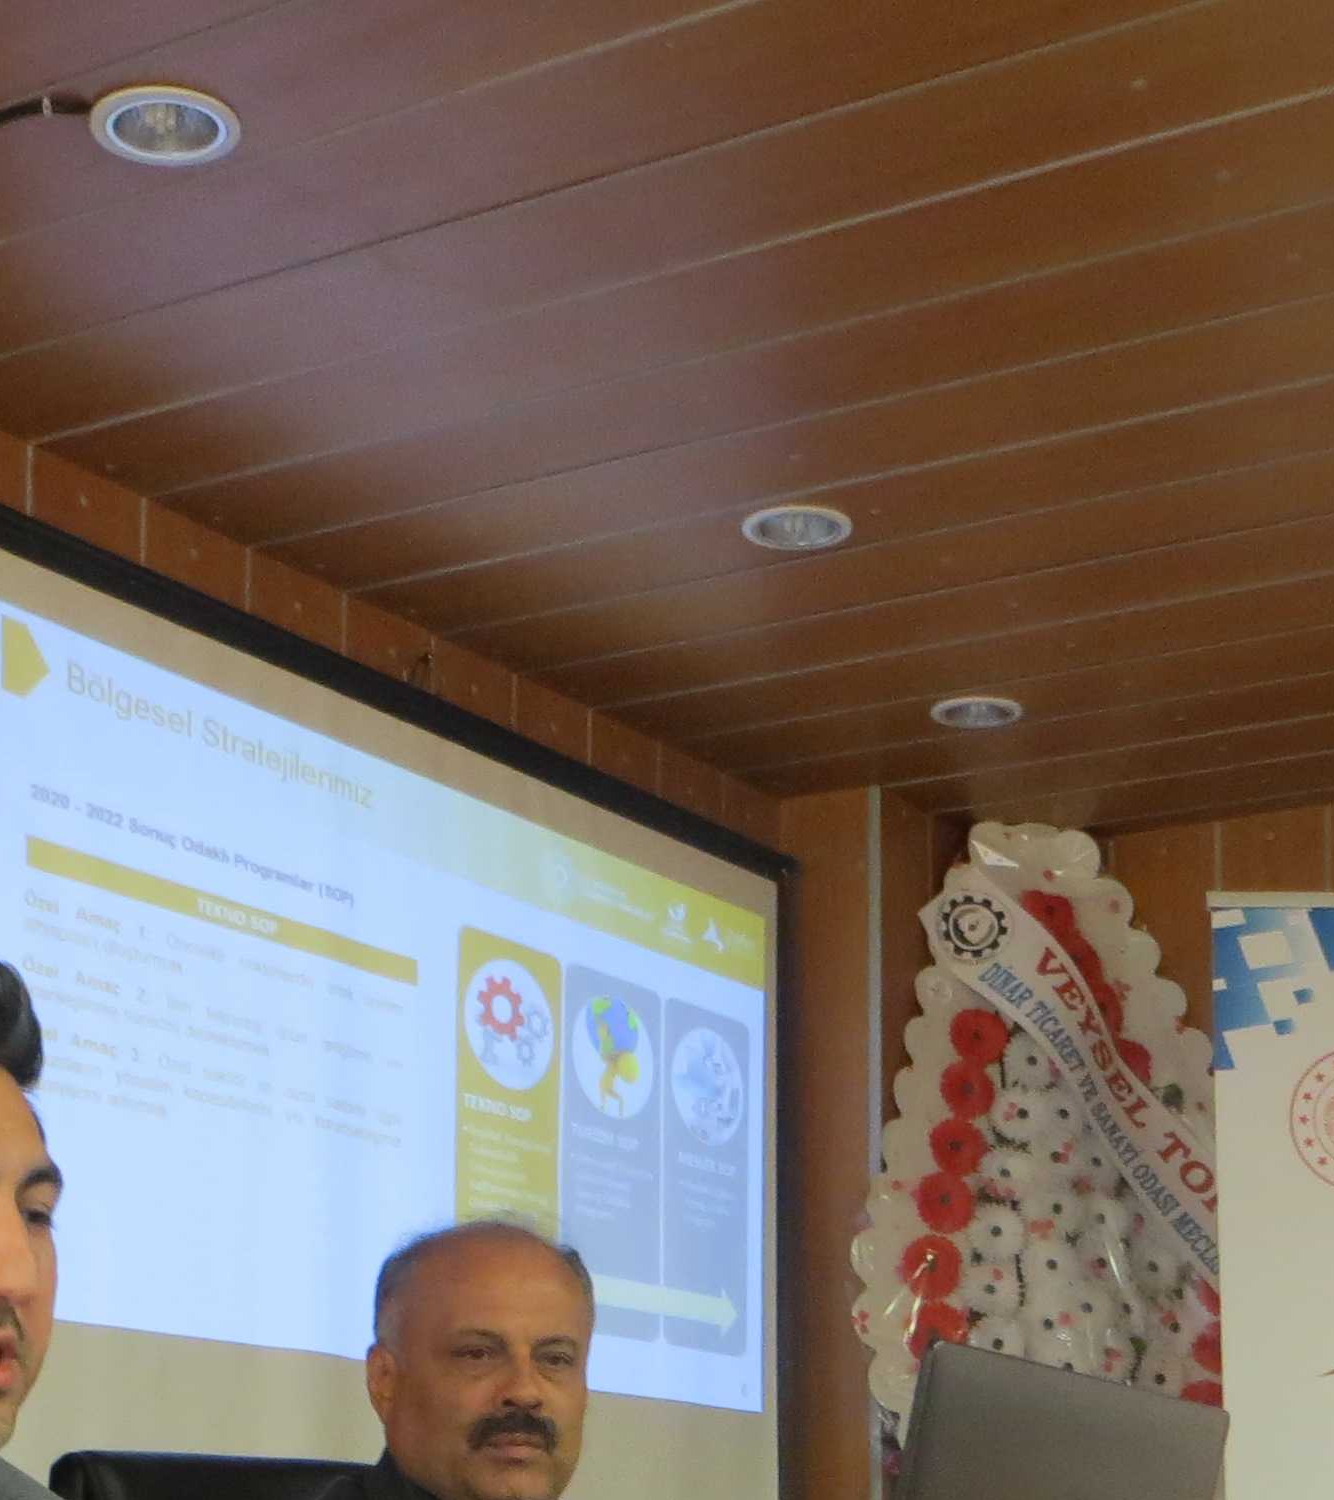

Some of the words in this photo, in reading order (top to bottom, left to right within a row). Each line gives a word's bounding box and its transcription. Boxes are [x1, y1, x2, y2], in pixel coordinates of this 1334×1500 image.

[67, 662, 194, 738] Bölgesel
[30, 784, 71, 810] 2020
[86, 803, 124, 828] 2022
[128, 817, 177, 850] Sonuç
[1035, 946, 1150, 1130] VEYSEL
[1157, 1131, 1218, 1214] TO
[1132, 1163, 1180, 1218] ODASI
